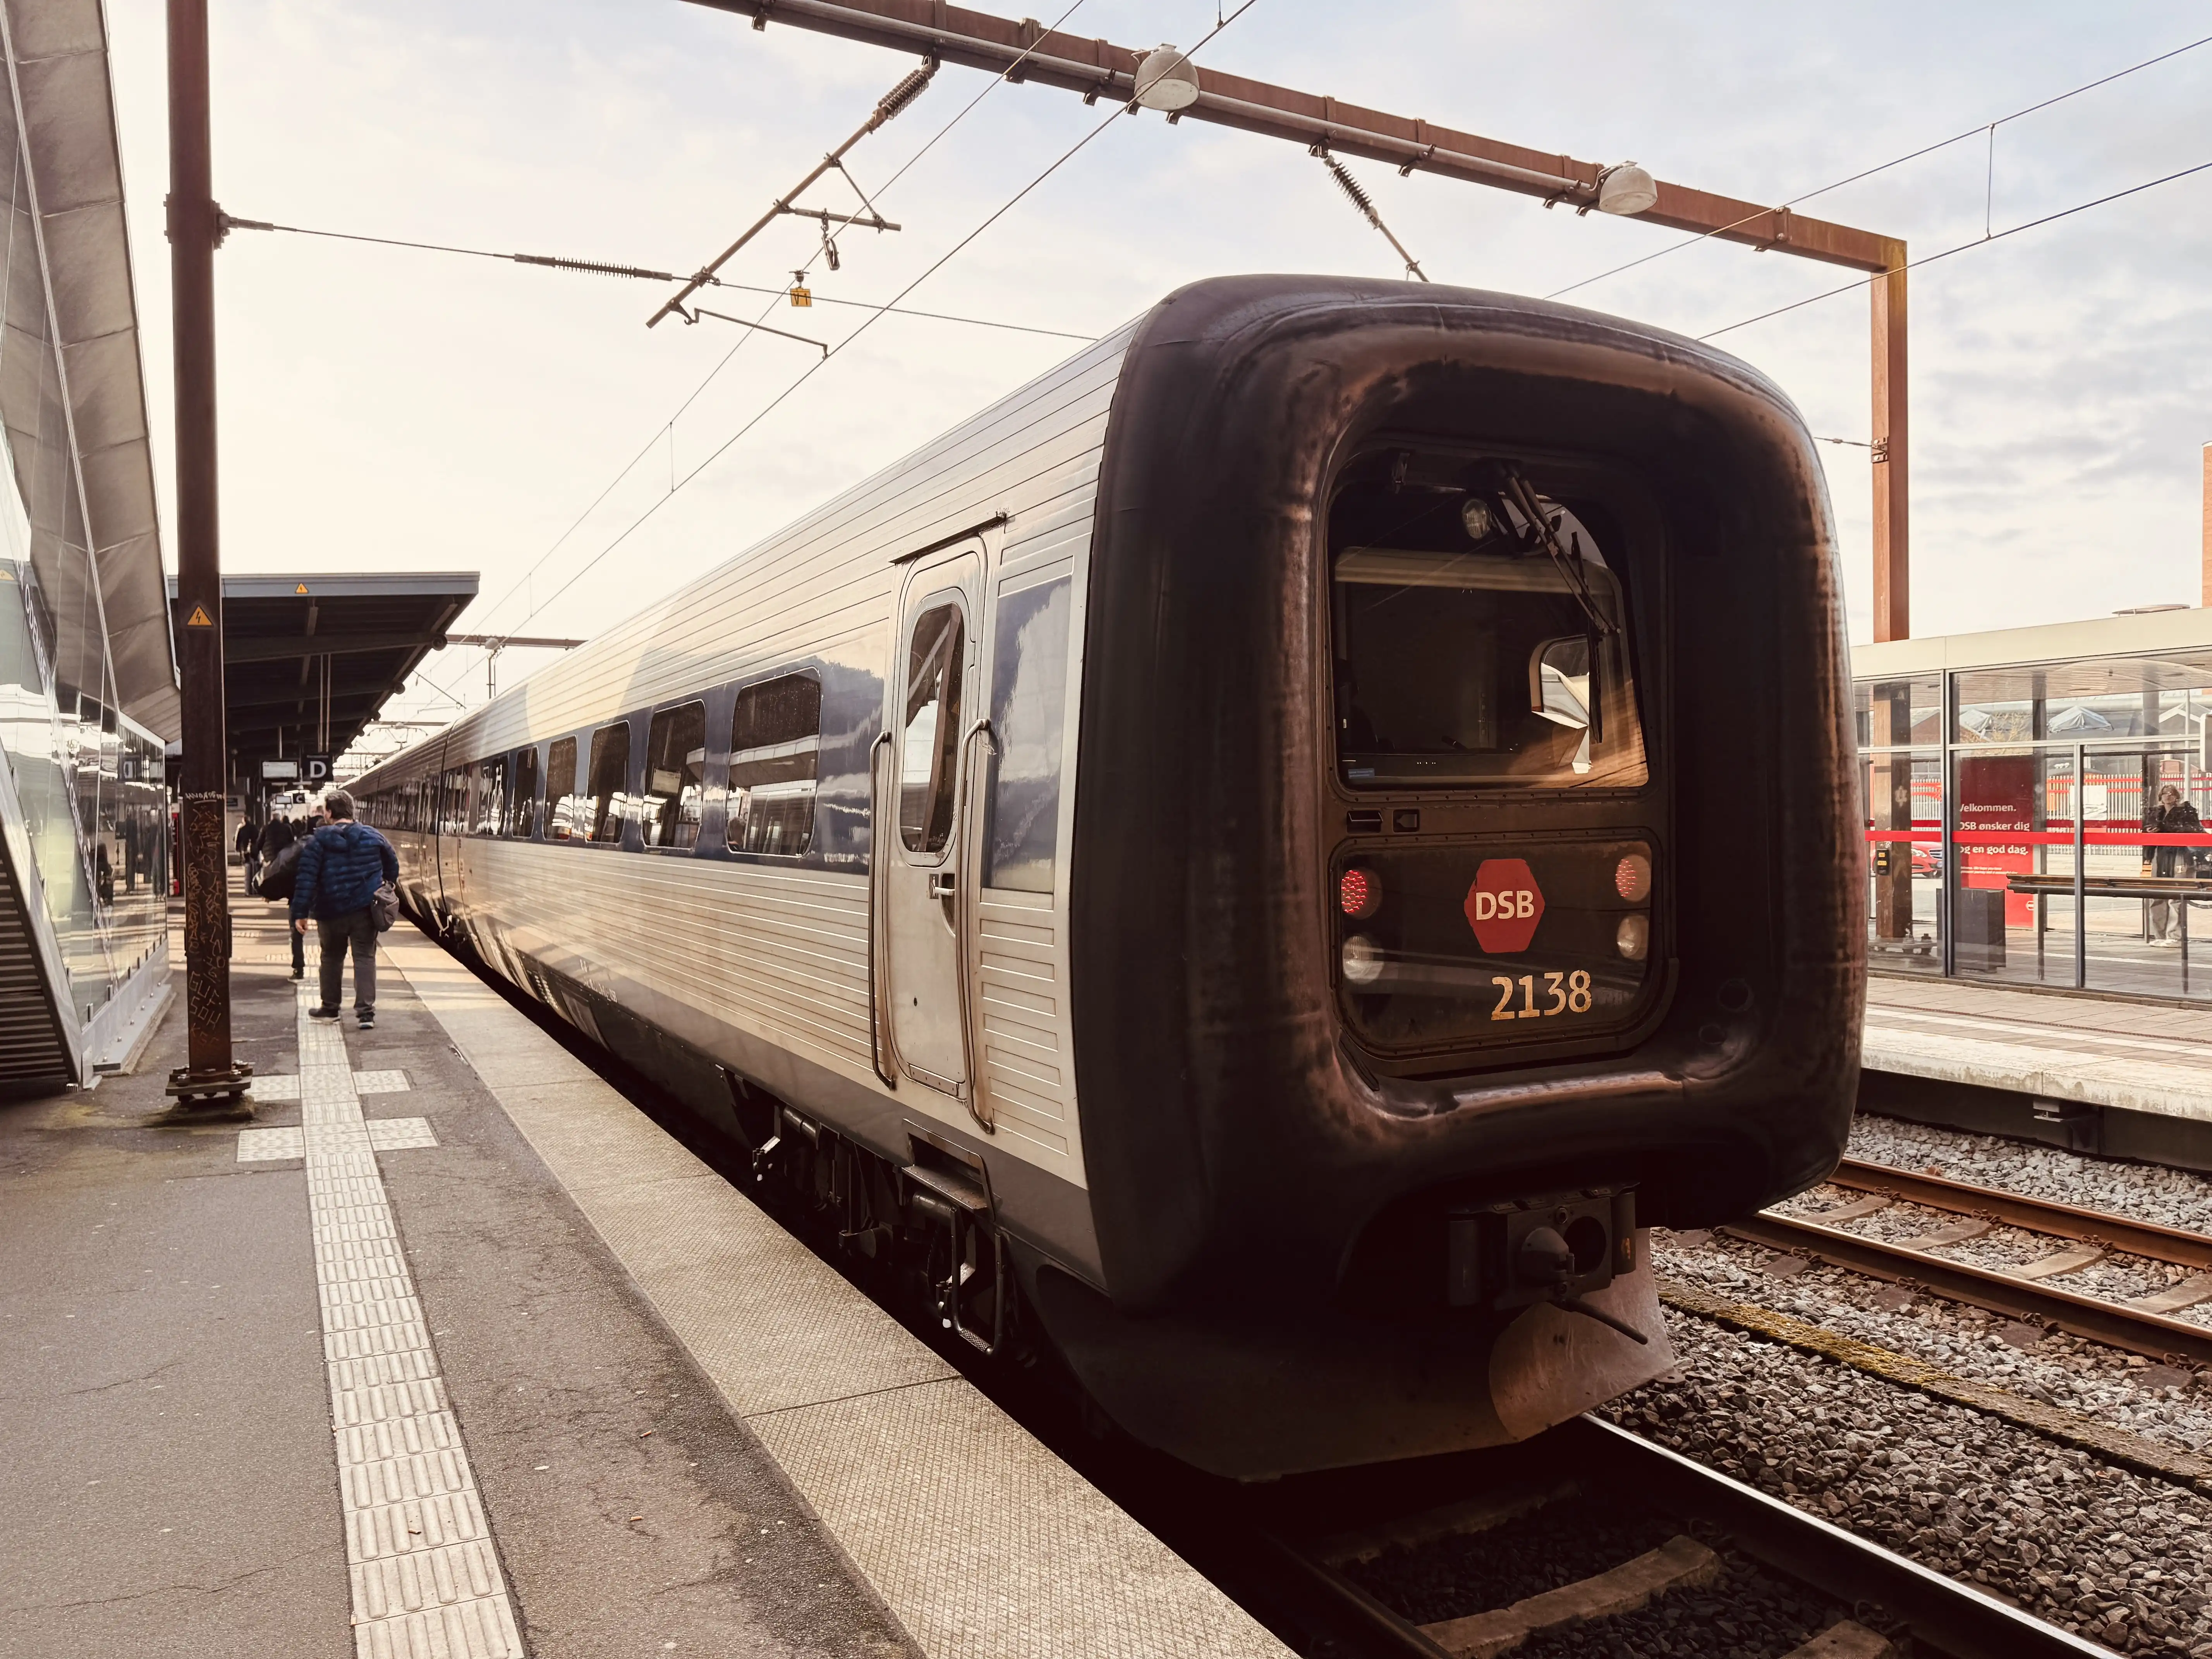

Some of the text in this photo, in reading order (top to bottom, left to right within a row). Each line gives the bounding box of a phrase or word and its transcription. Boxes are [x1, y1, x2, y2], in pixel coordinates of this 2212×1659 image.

[310, 761, 327, 778] D
[1979, 821, 2012, 830] ønsker
[2014, 821, 2030, 832] dig
[1987, 845, 2006, 855] god
[2008, 845, 2028, 855] dag.
[1475, 890, 1535, 920] DSB
[1491, 970, 1592, 1020] 2138
